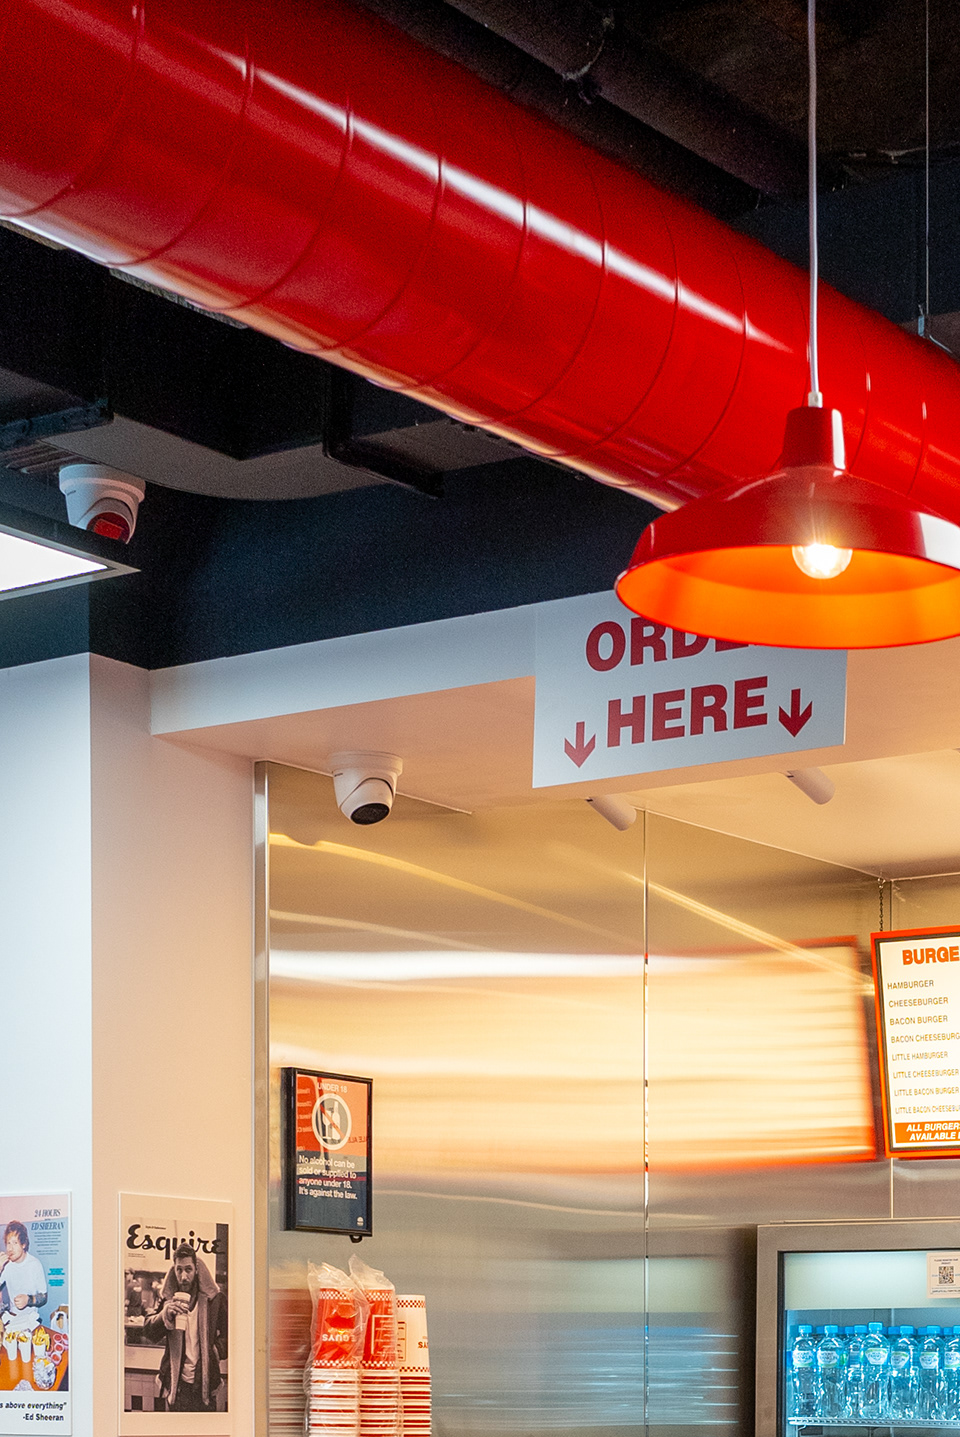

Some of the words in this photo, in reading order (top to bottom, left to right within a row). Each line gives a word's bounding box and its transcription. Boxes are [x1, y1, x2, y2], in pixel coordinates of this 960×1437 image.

[607, 675, 768, 748] HERE
[887, 979, 934, 990] HAMBURGER
[888, 996, 949, 1008] CHEESEBURGER
[318, 1082, 339, 1092] UNDER
[340, 1085, 348, 1093] 18
[299, 1155, 309, 1163] No
[310, 1156, 333, 1167] alcohol
[346, 1160, 355, 1168] be
[299, 1166, 313, 1175] sold
[322, 1168, 349, 1178] supplied
[349, 1171, 357, 1179] to
[298, 1177, 322, 1186] anyone
[323, 1179, 342, 1188] under
[309, 1188, 333, 1198] against
[333, 1190, 344, 1198] the
[126, 1223, 225, 1260] Esquire
[5, 1401, 26, 1409] above
[35, 1413, 64, 1421] Sheeran
